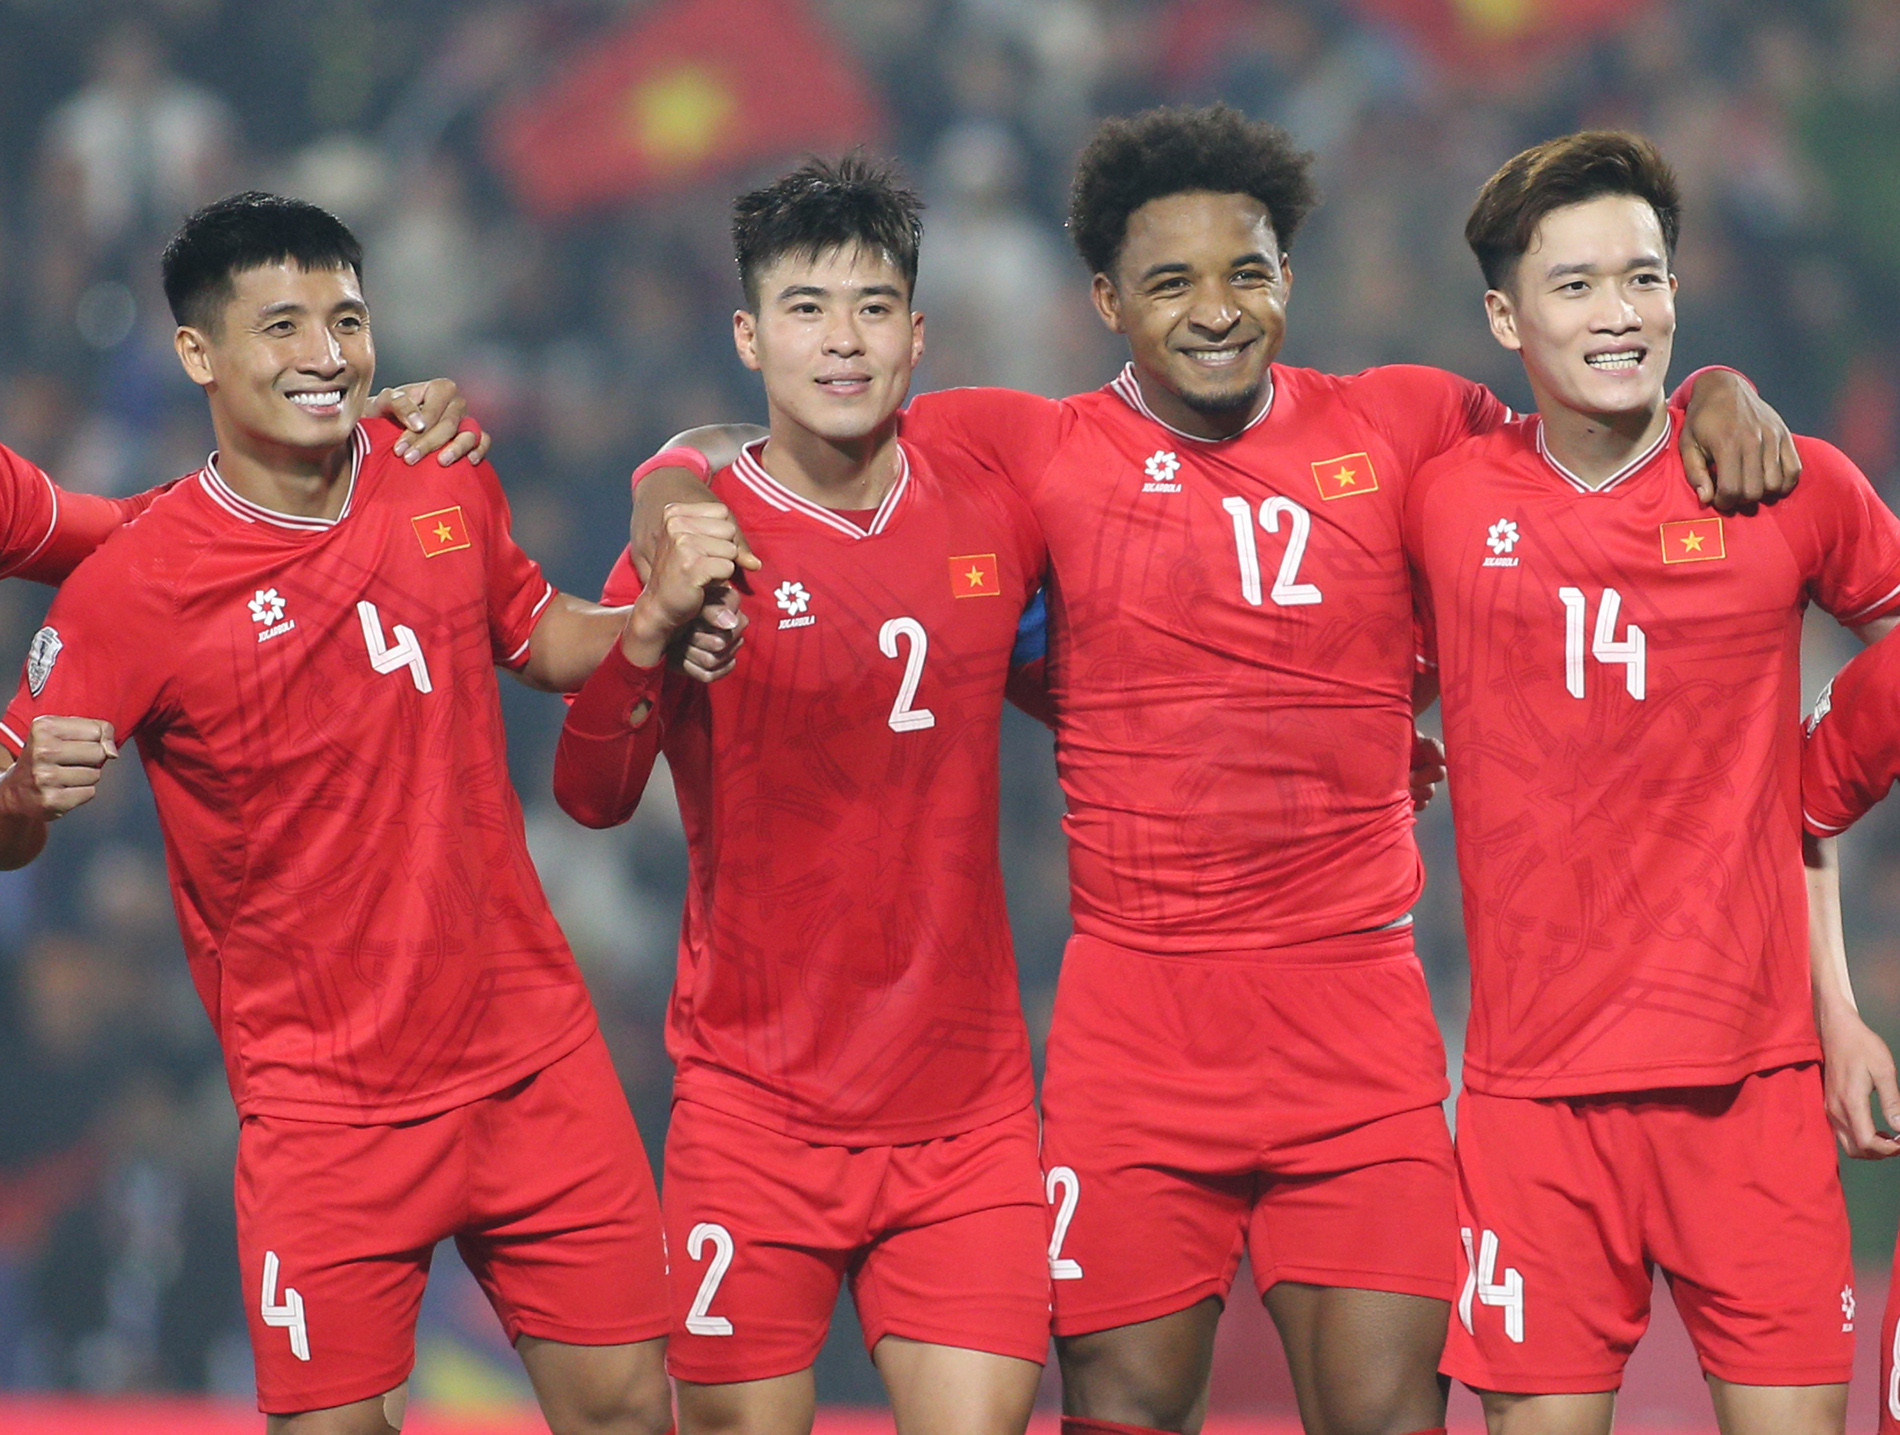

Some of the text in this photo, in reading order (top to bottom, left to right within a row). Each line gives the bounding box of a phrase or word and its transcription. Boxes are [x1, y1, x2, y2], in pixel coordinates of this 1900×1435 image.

[1221, 495, 1322, 606] 12
[356, 600, 433, 694] 4
[878, 616, 935, 733] 2
[1558, 586, 1646, 701] 14
[260, 1250, 311, 1362] 4
[685, 1222, 734, 1336] 2
[1458, 1226, 1524, 1343] 14
